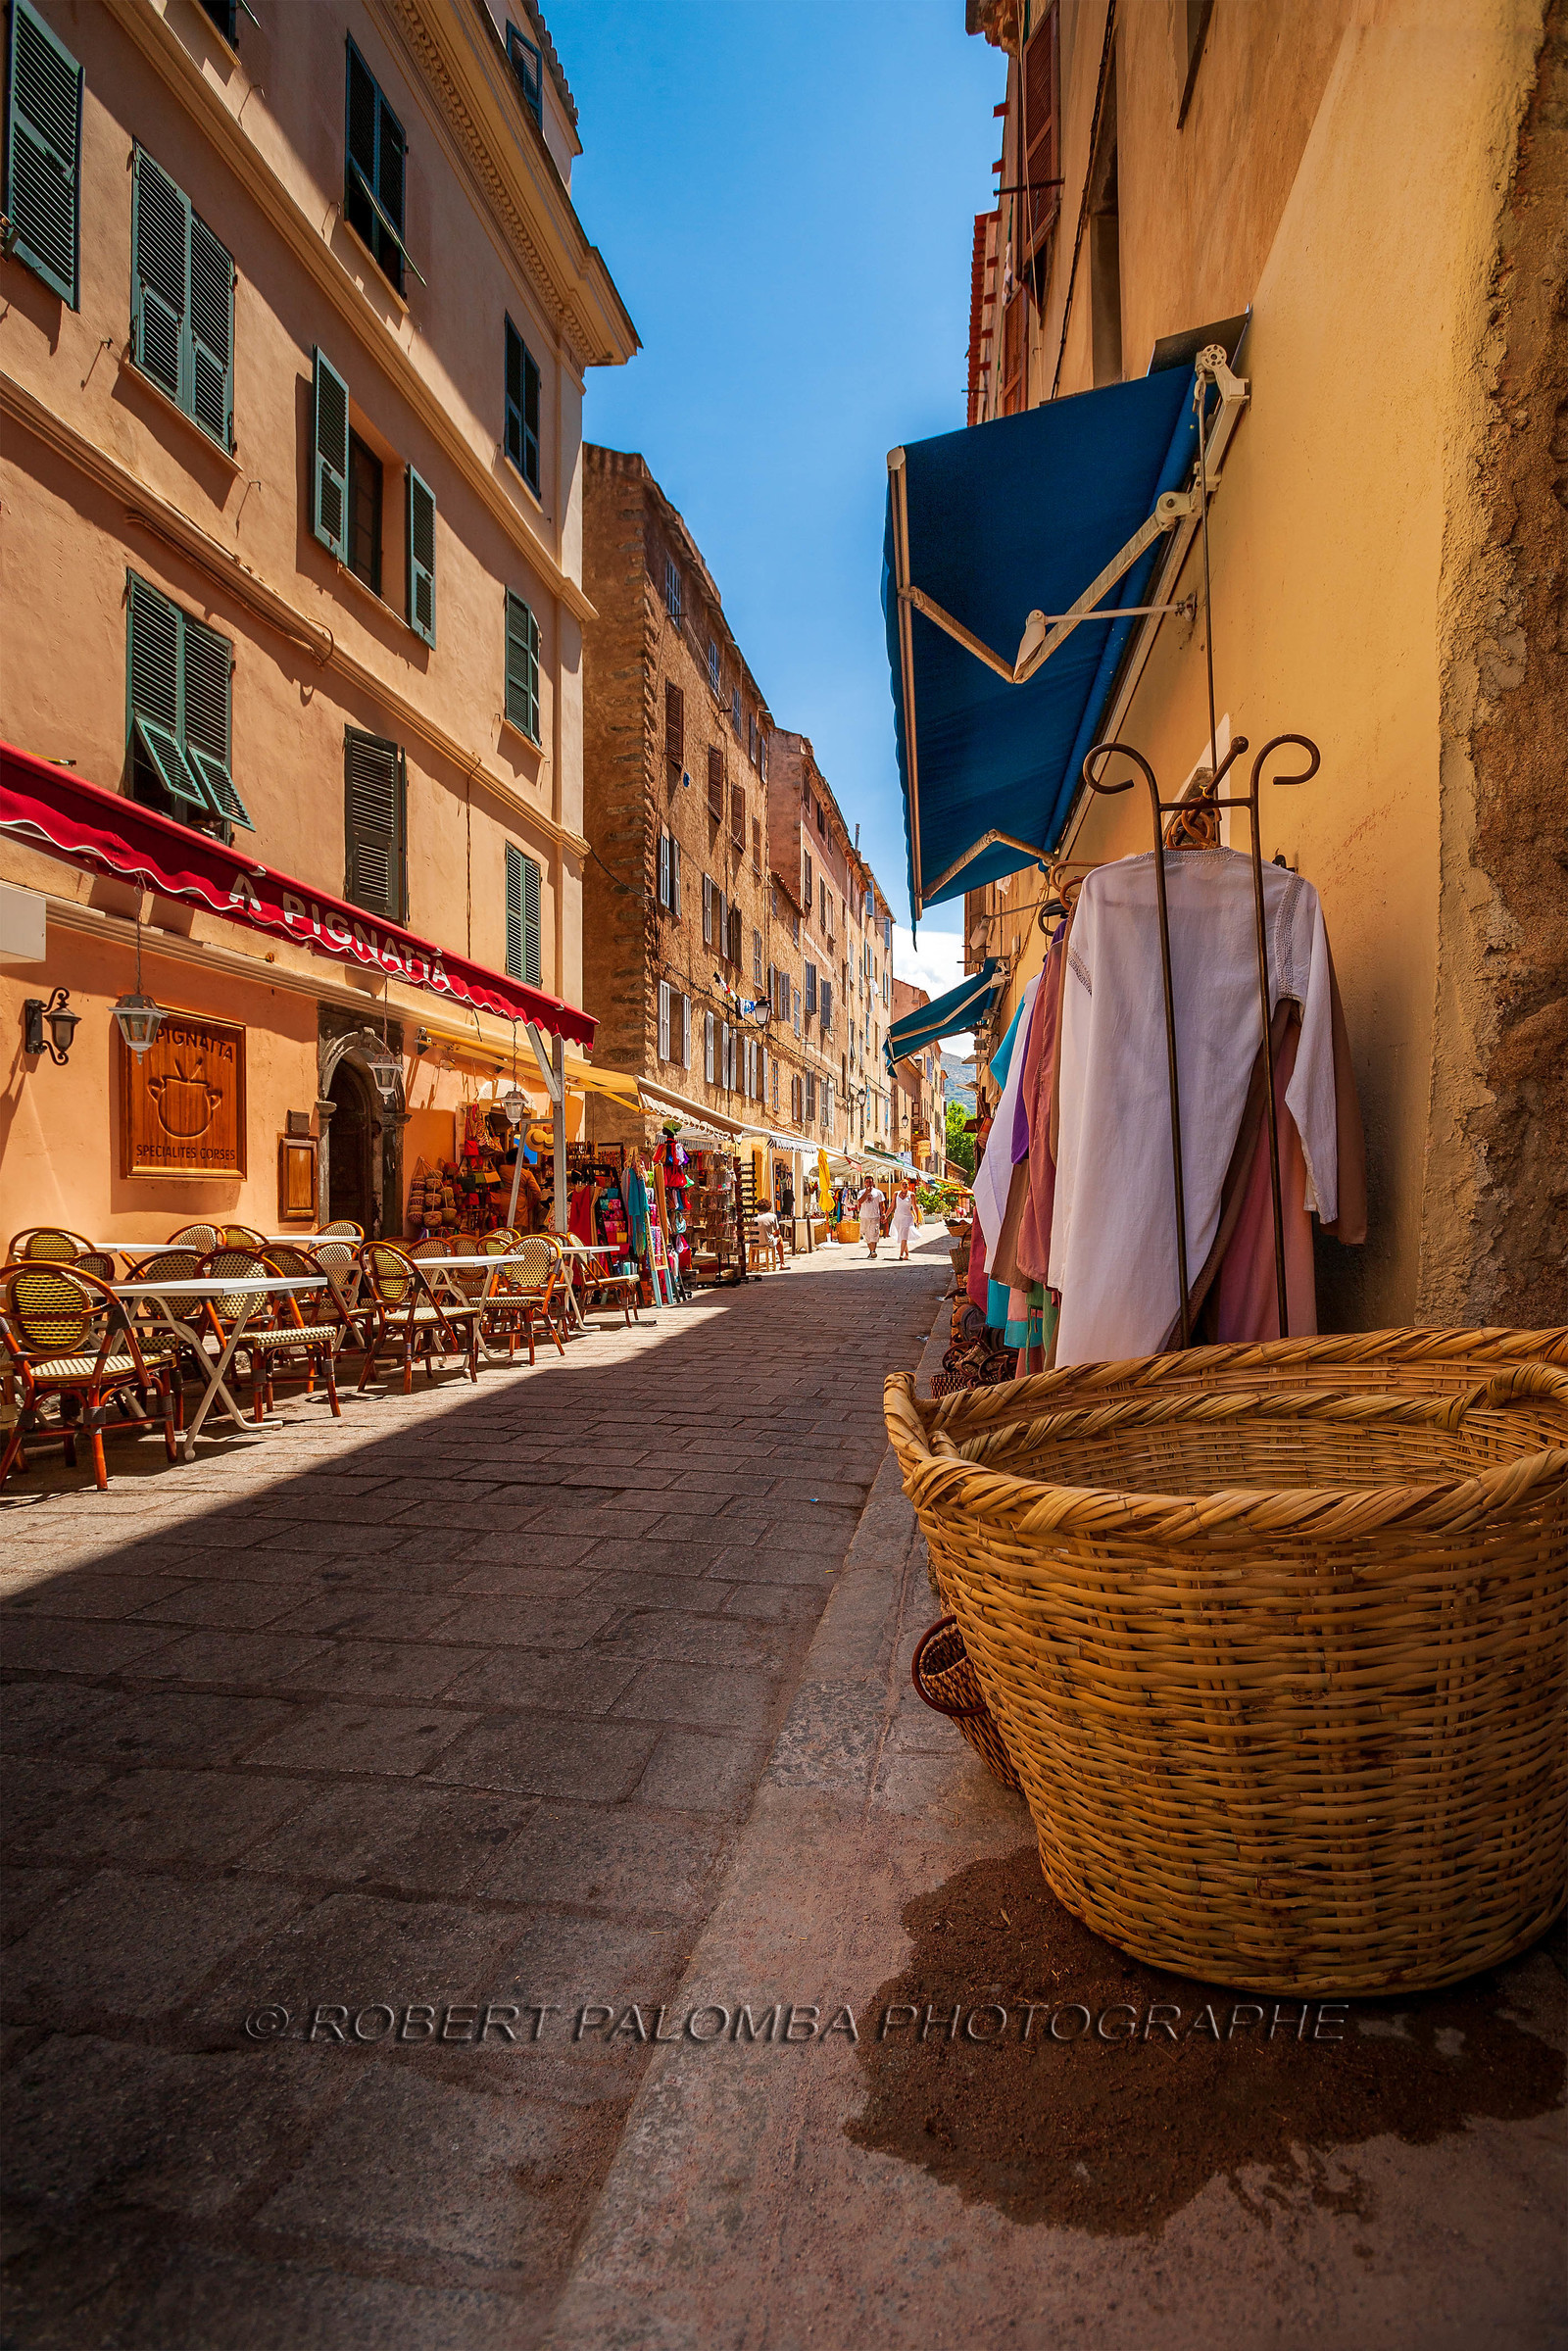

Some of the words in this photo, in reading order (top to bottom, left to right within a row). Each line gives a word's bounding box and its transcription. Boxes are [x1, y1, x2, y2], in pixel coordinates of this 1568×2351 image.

[229, 873, 263, 911] A
[282, 891, 452, 988] PIGNATTA
[155, 1026, 233, 1063] PIGNATTA
[136, 1144, 197, 1159] SPECIALITES
[199, 1148, 236, 1161] CORSES
